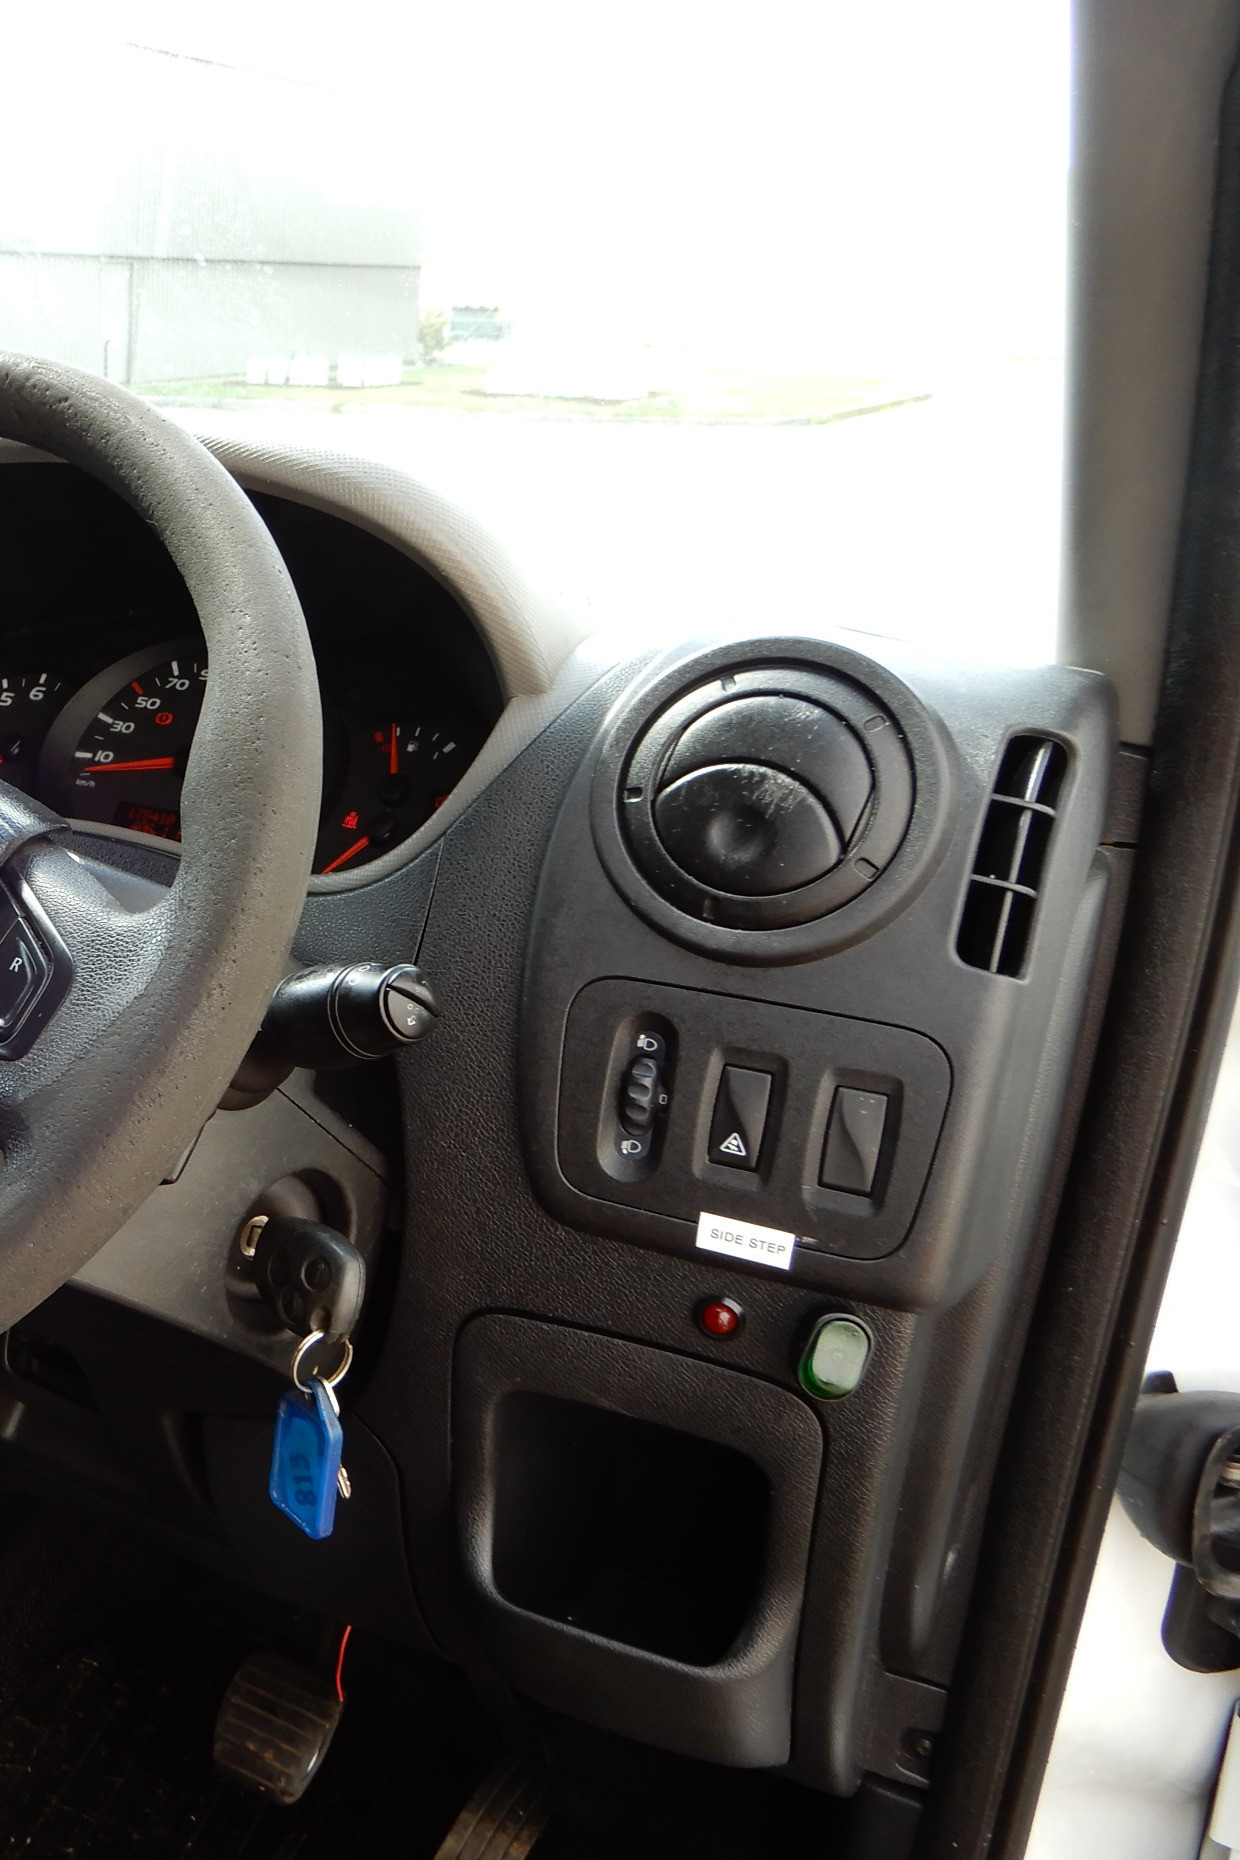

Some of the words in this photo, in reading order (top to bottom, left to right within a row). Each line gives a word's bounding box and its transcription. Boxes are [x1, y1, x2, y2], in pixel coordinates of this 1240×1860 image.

[199, 669, 209, 680] 9
[165, 678, 190, 691] 70
[29, 686, 47, 700] 6
[134, 696, 161, 709] 50
[109, 720, 135, 733] 30
[94, 750, 114, 763] 10
[75, 778, 95, 788] km/h
[9, 957, 22, 973] R
[710, 1228, 744, 1246] SIDE
[748, 1238, 786, 1254] STEP
